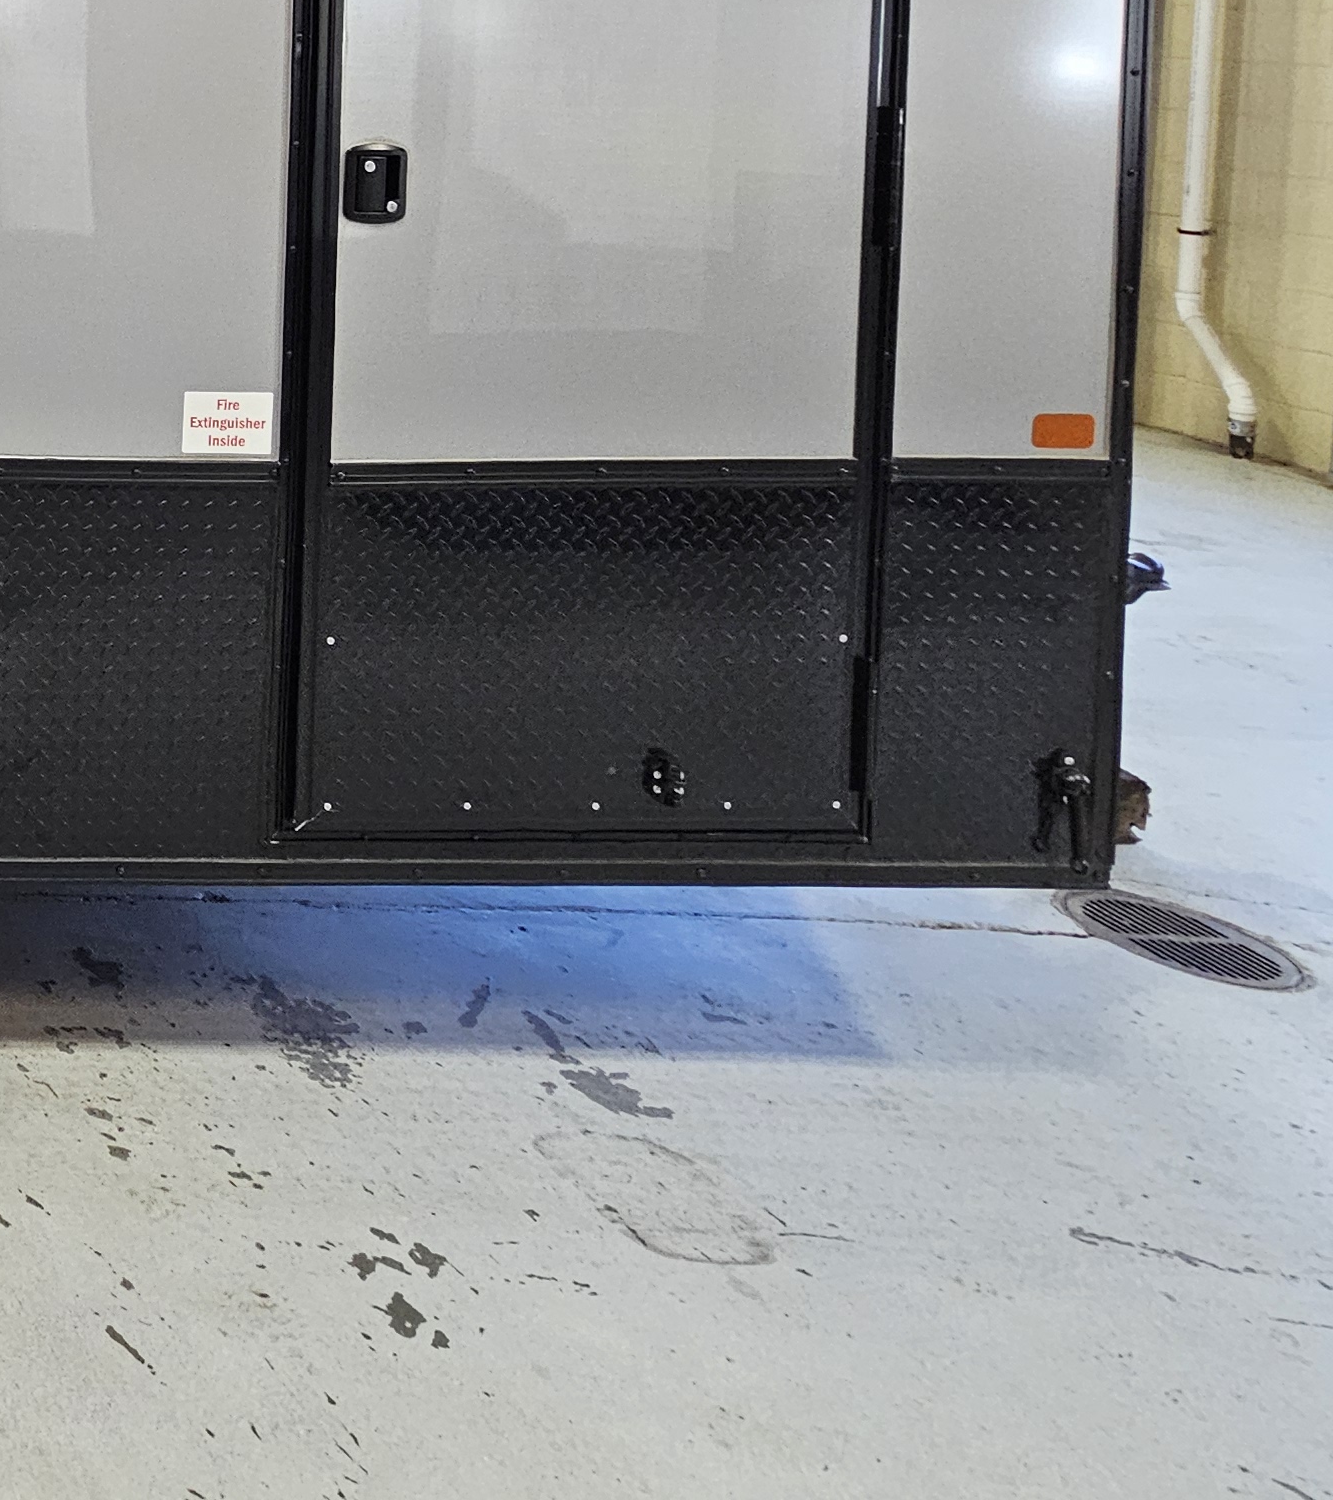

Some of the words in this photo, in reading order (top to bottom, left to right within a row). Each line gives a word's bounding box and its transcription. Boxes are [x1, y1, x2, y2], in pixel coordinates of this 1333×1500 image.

[217, 399, 240, 411] Fire
[190, 417, 266, 431] Extinguisher
[208, 435, 246, 447] Inside
